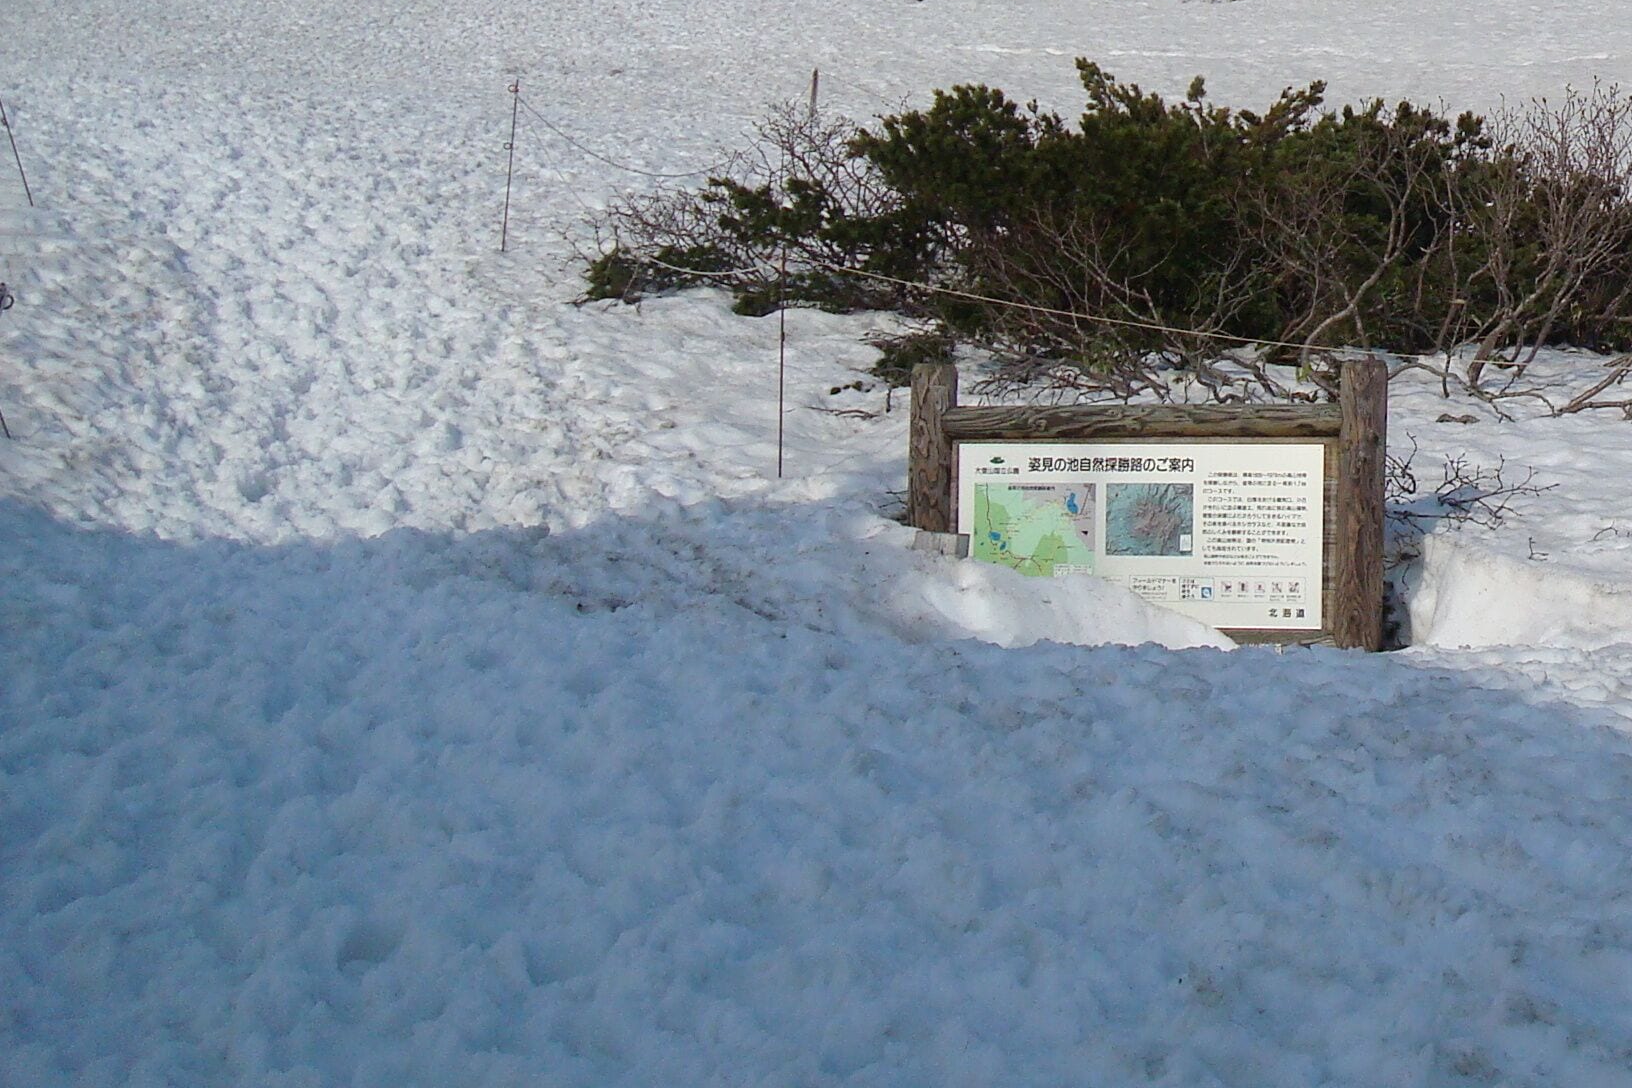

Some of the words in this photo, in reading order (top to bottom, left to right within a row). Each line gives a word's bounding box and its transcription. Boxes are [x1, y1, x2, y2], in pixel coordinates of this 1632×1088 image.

[1028, 457, 1194, 473] 姿見の池自然探勝路のご案内
[1268, 608, 1305, 618] 北海道
